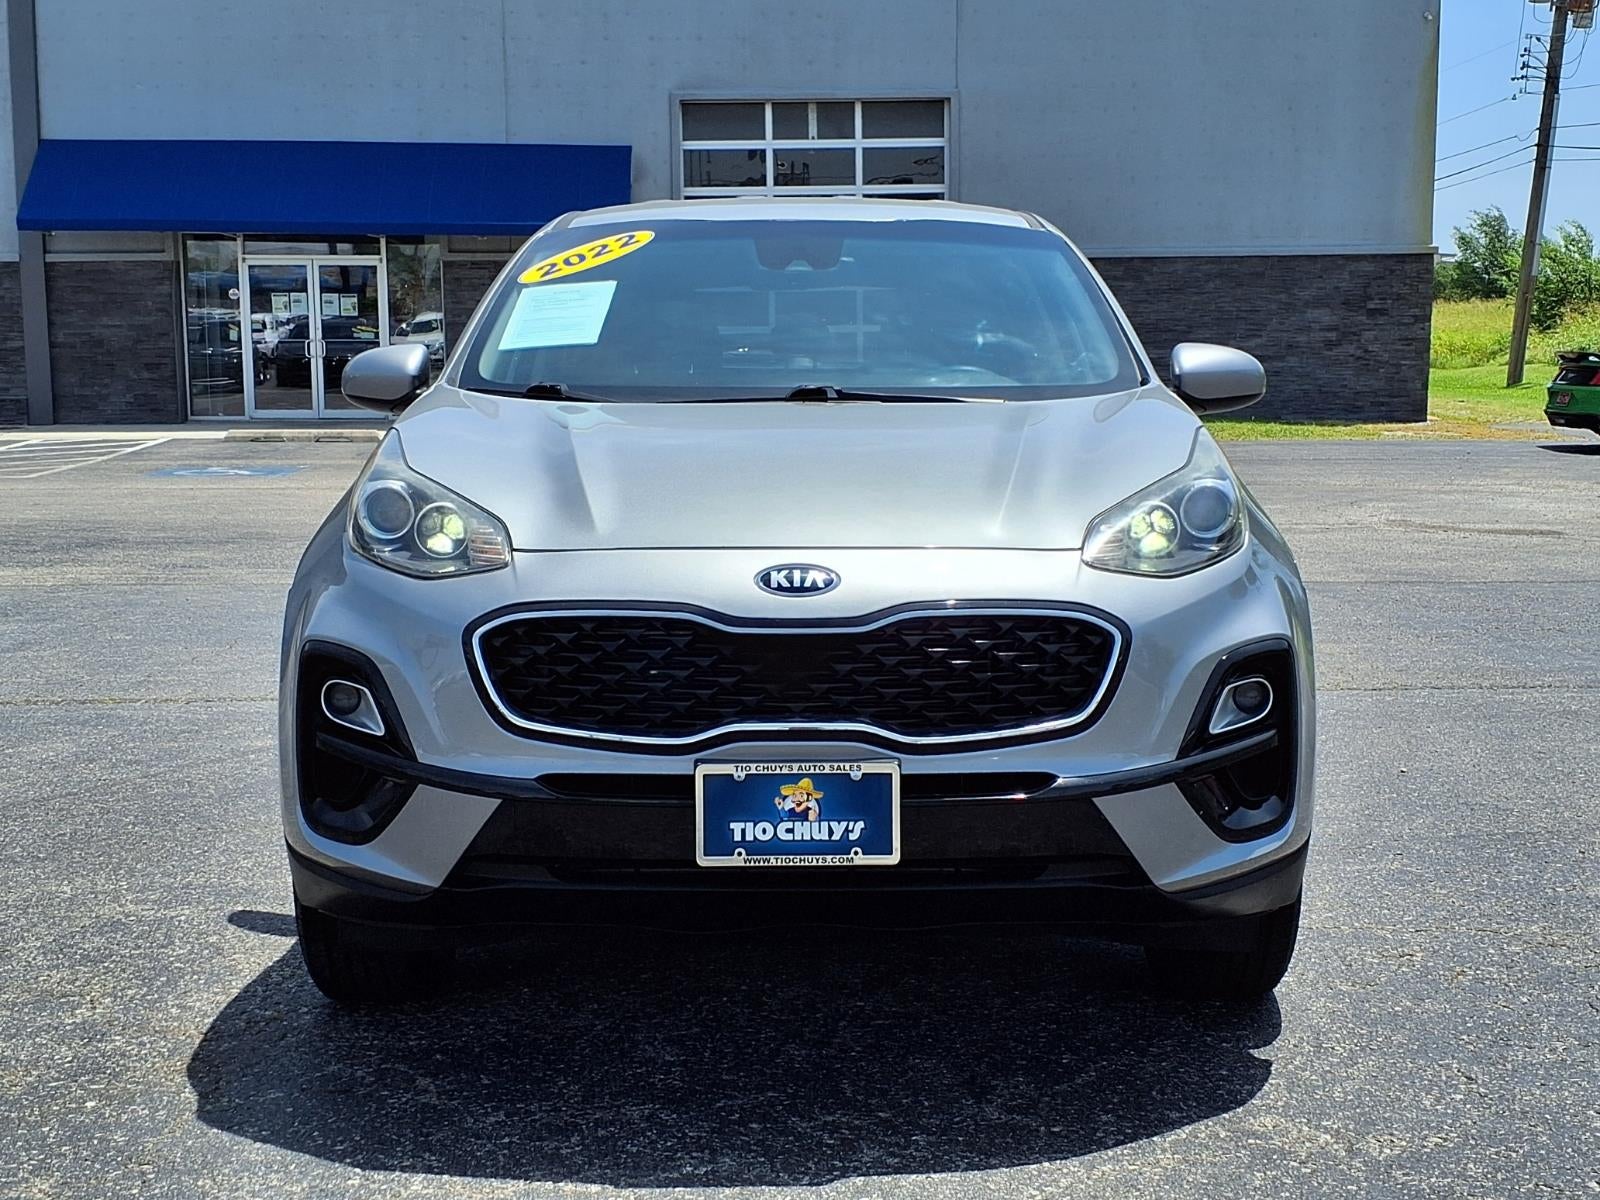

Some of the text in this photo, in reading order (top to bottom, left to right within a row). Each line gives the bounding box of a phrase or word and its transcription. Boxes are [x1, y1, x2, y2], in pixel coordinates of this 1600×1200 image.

[536, 234, 640, 279] 2022
[769, 569, 826, 588] KIA
[734, 764, 862, 773] TIO CHUY'S AUTO SALES
[743, 856, 855, 865] WWW.TIOCHUYS.COM
